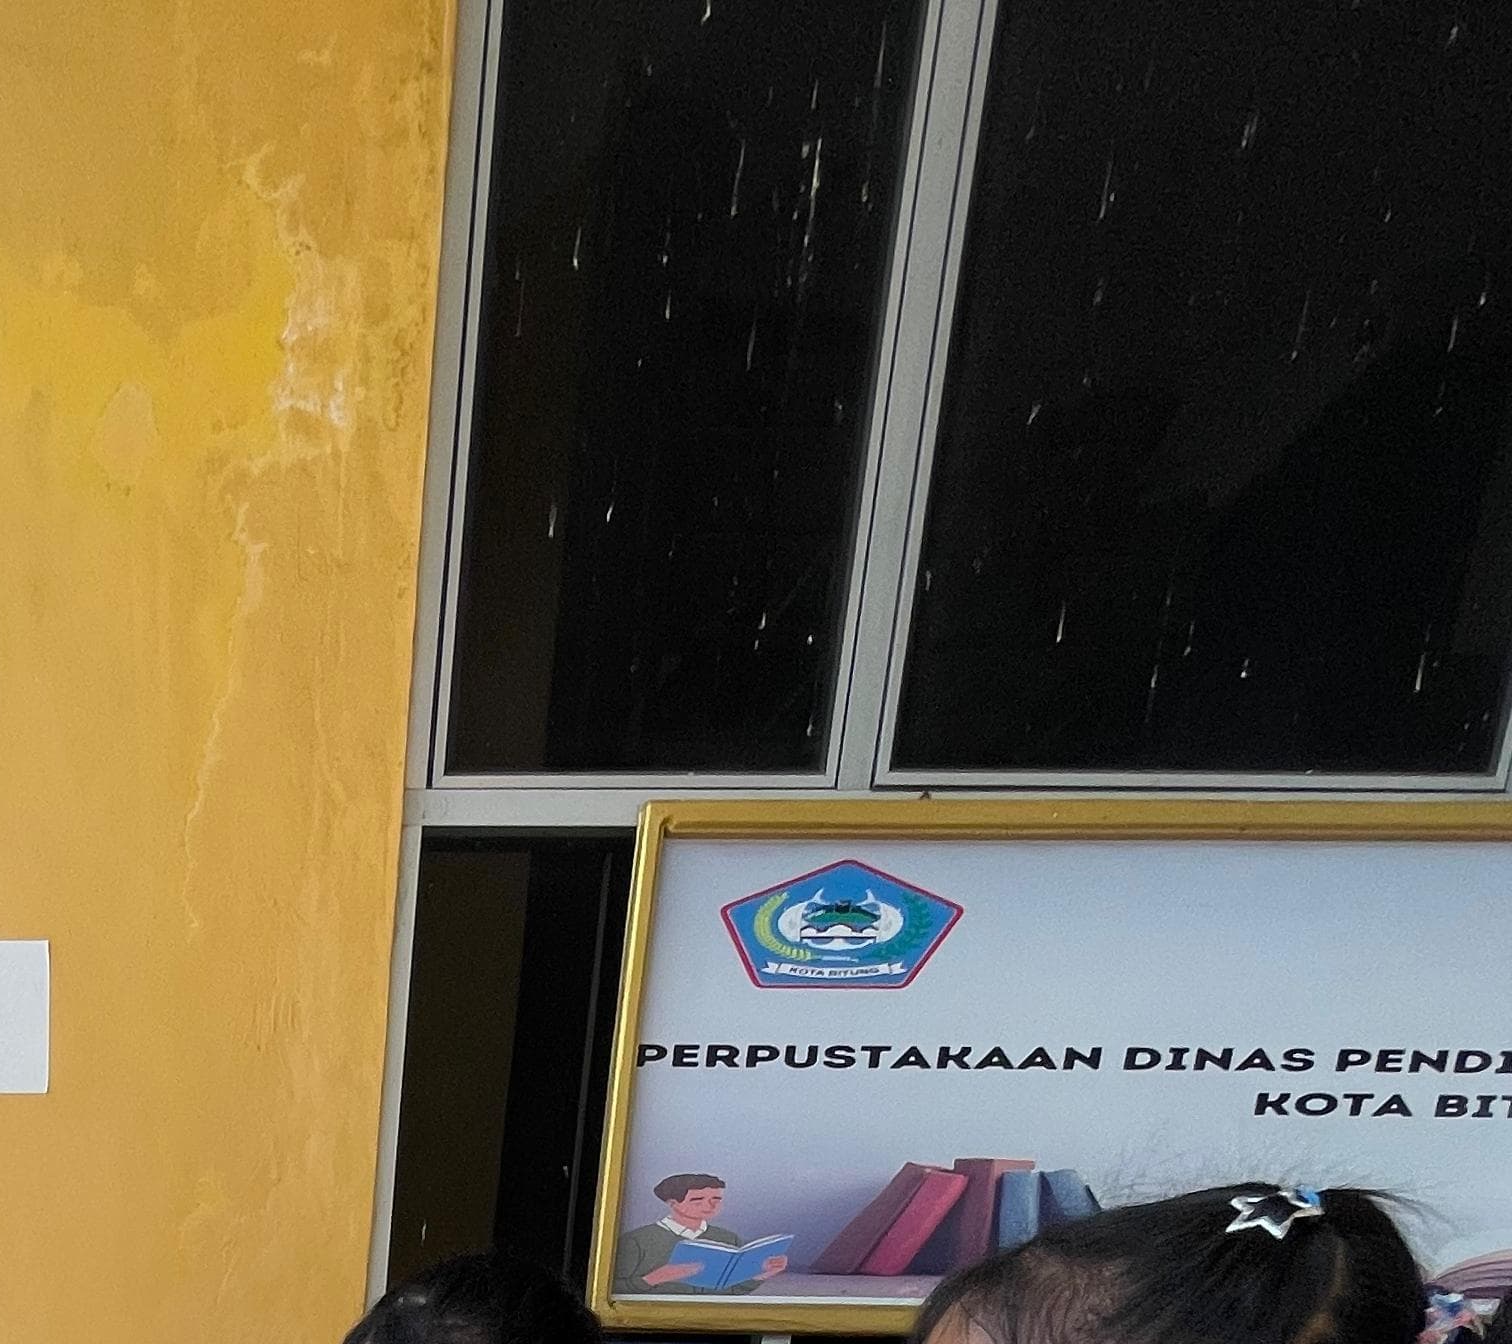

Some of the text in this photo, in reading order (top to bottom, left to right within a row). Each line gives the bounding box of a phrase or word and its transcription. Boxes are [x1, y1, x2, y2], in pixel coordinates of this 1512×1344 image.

[788, 966, 880, 978] KOTA BITUNG
[635, 1043, 1103, 1071] PERPUSTAKAAN
[1123, 1047, 1315, 1072] DINAS
[1254, 1092, 1413, 1118] KOTA
